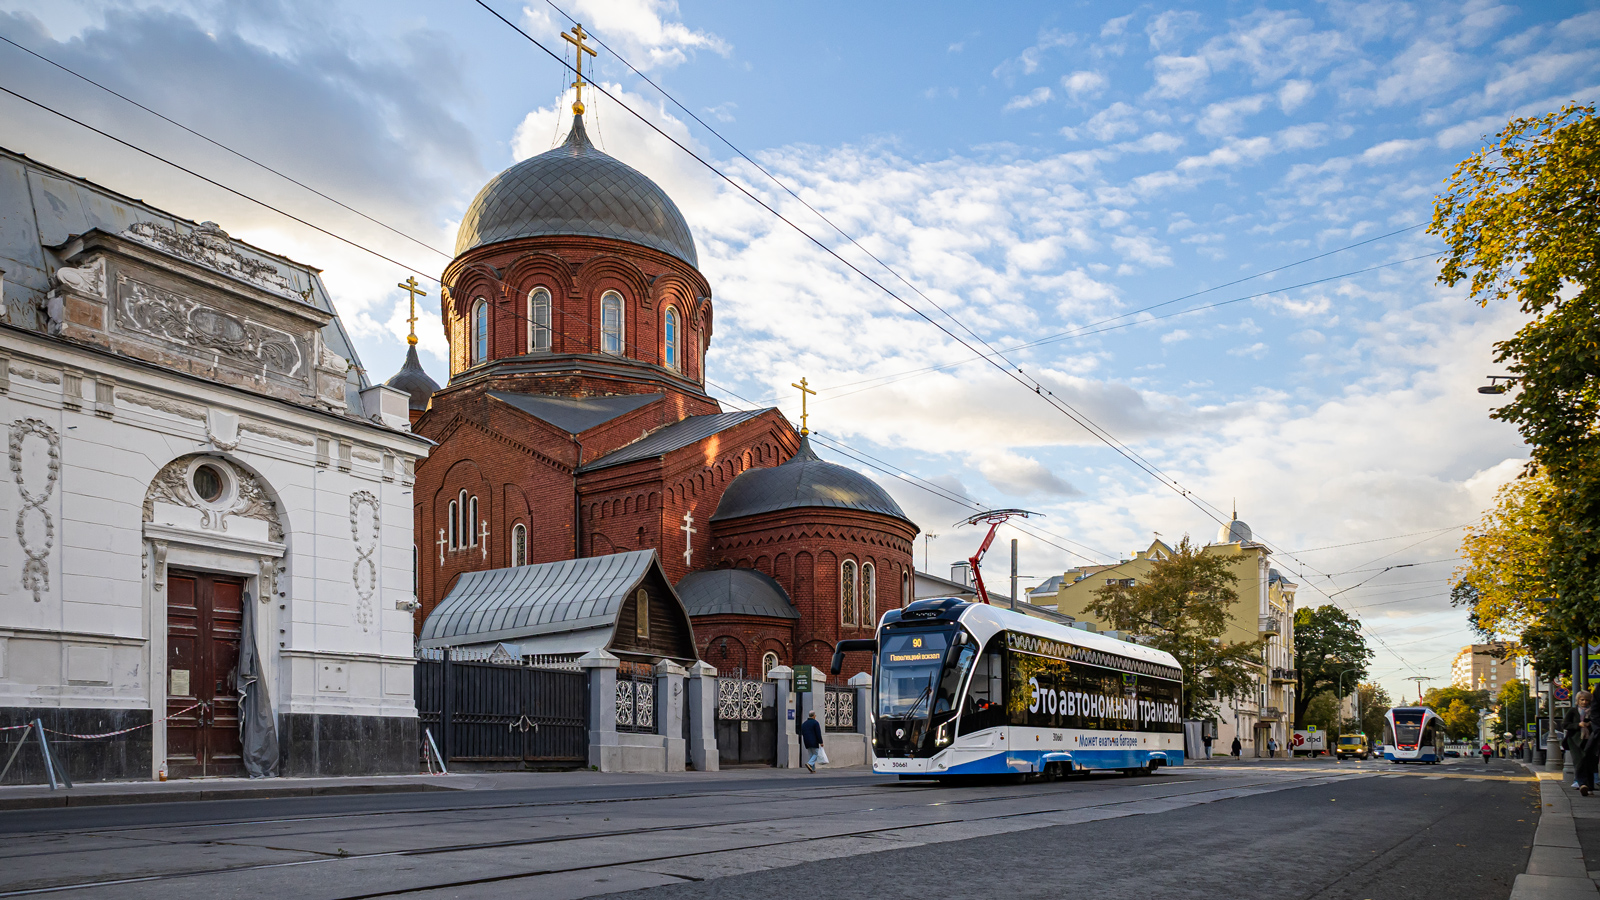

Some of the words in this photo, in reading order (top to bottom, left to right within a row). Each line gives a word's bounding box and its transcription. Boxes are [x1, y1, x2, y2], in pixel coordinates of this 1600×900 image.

[912, 638, 922, 648] 90
[1029, 677, 1058, 715] Это
[1059, 688, 1138, 721] автономный
[1139, 698, 1182, 728] трамвай.
[1078, 734, 1098, 748] Может
[1098, 737, 1112, 747] ехать
[1119, 734, 1138, 749] батарее
[1306, 735, 1321, 744] dpd
